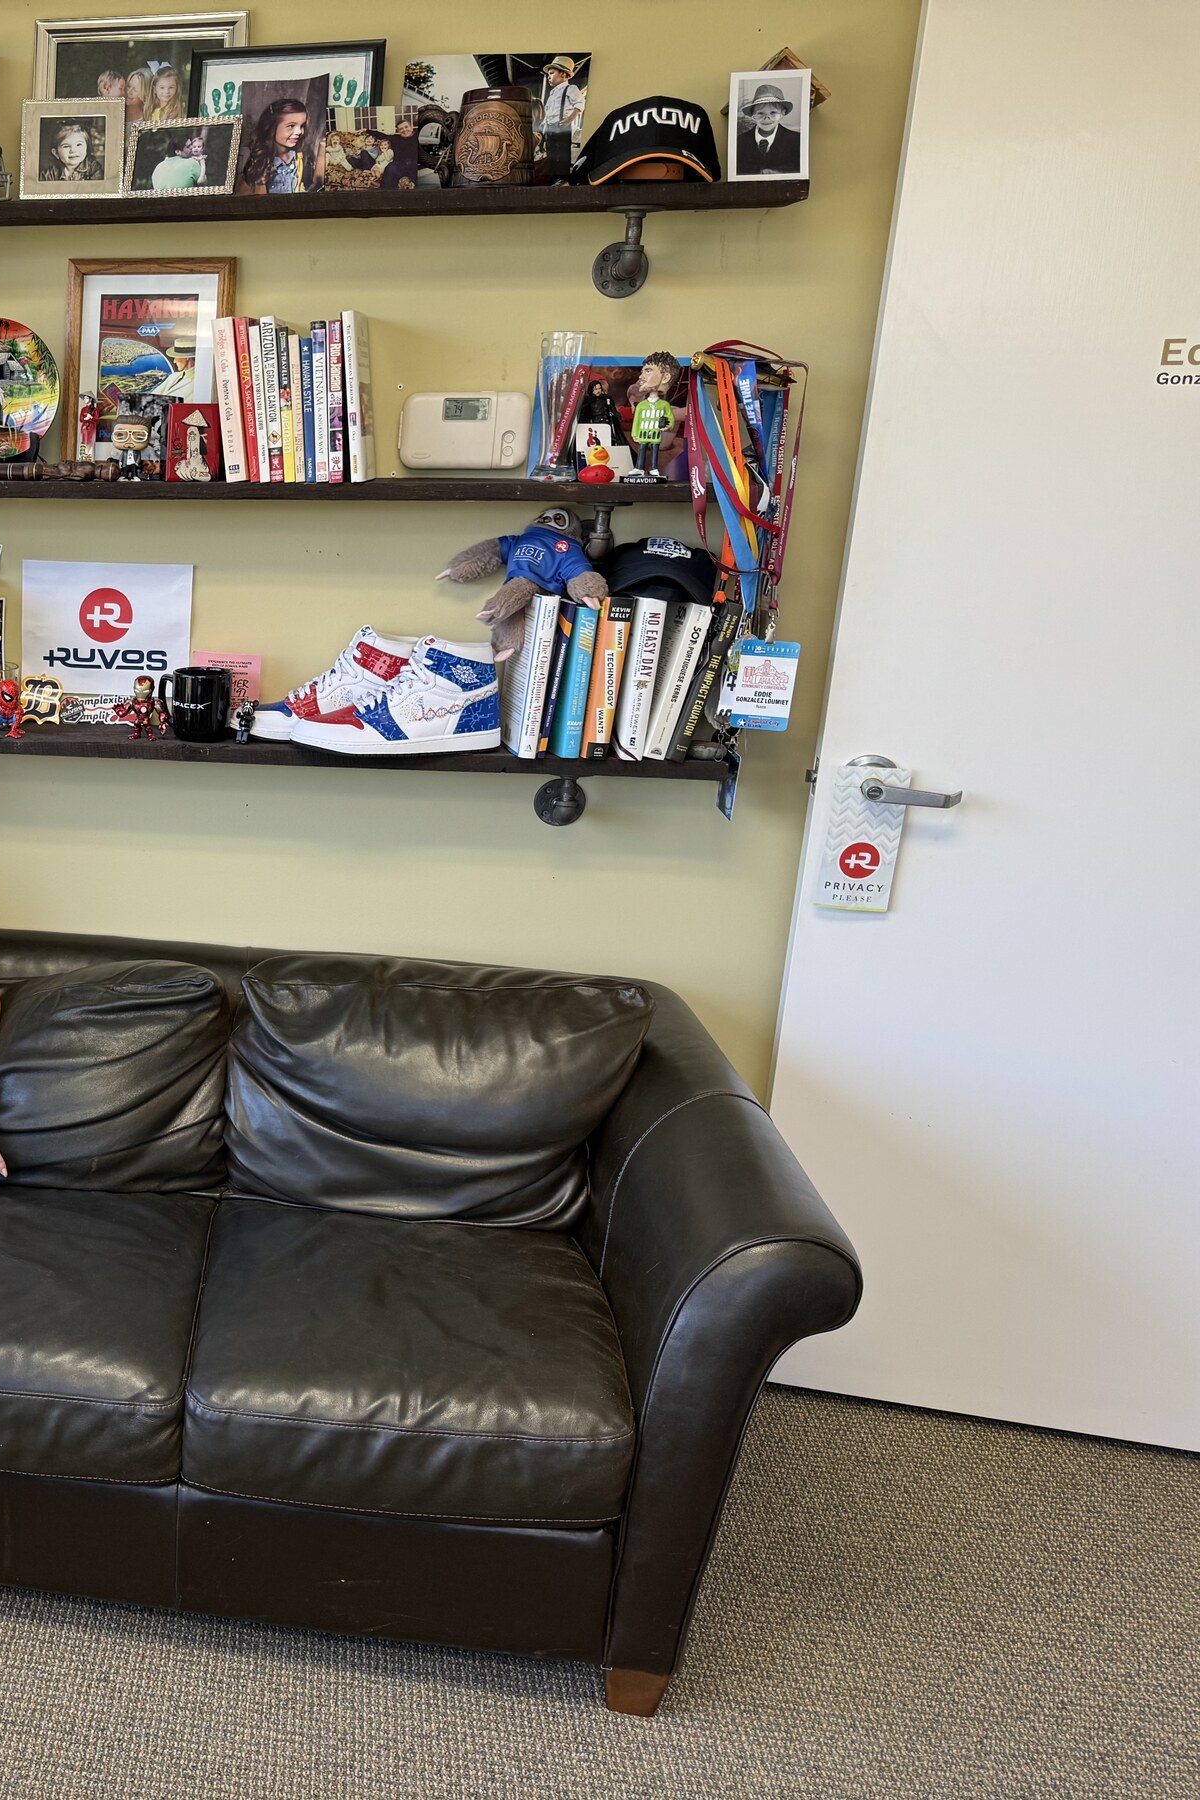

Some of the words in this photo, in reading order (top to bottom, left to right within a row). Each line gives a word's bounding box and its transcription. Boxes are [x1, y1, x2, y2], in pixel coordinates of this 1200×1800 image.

[102, 298, 198, 322] HAVANA
[262, 322, 274, 362] ARIZONA
[240, 354, 250, 384] CUBA
[302, 360, 310, 390] HAVANA
[266, 370, 275, 396] GRAND
[315, 358, 324, 405] VIETNAM
[739, 379, 753, 404] TIME
[268, 397, 277, 422] CANYON
[304, 392, 312, 412] STYLE
[745, 404, 756, 424] LIFE
[780, 409, 788, 445] ESCORTED
[648, 612, 661, 626] NO
[577, 615, 596, 654] SPRINT
[643, 630, 658, 654] EASY
[689, 626, 702, 644] 501
[557, 642, 566, 676] PROFESSIONALLY
[640, 658, 654, 677] DAY
[677, 646, 694, 684] PORTUGUESE
[709, 654, 722, 670] THE
[670, 683, 682, 703] VERBS
[700, 670, 716, 700] IMPACT
[173, 701, 211, 709] SPACEX
[635, 692, 643, 712] MARK
[529, 705, 542, 737] Workout
[632, 714, 640, 735] OWEN
[683, 699, 705, 737] EQUATION
[824, 881, 884, 892] PRIVACY
[832, 894, 872, 902] PLEASE
